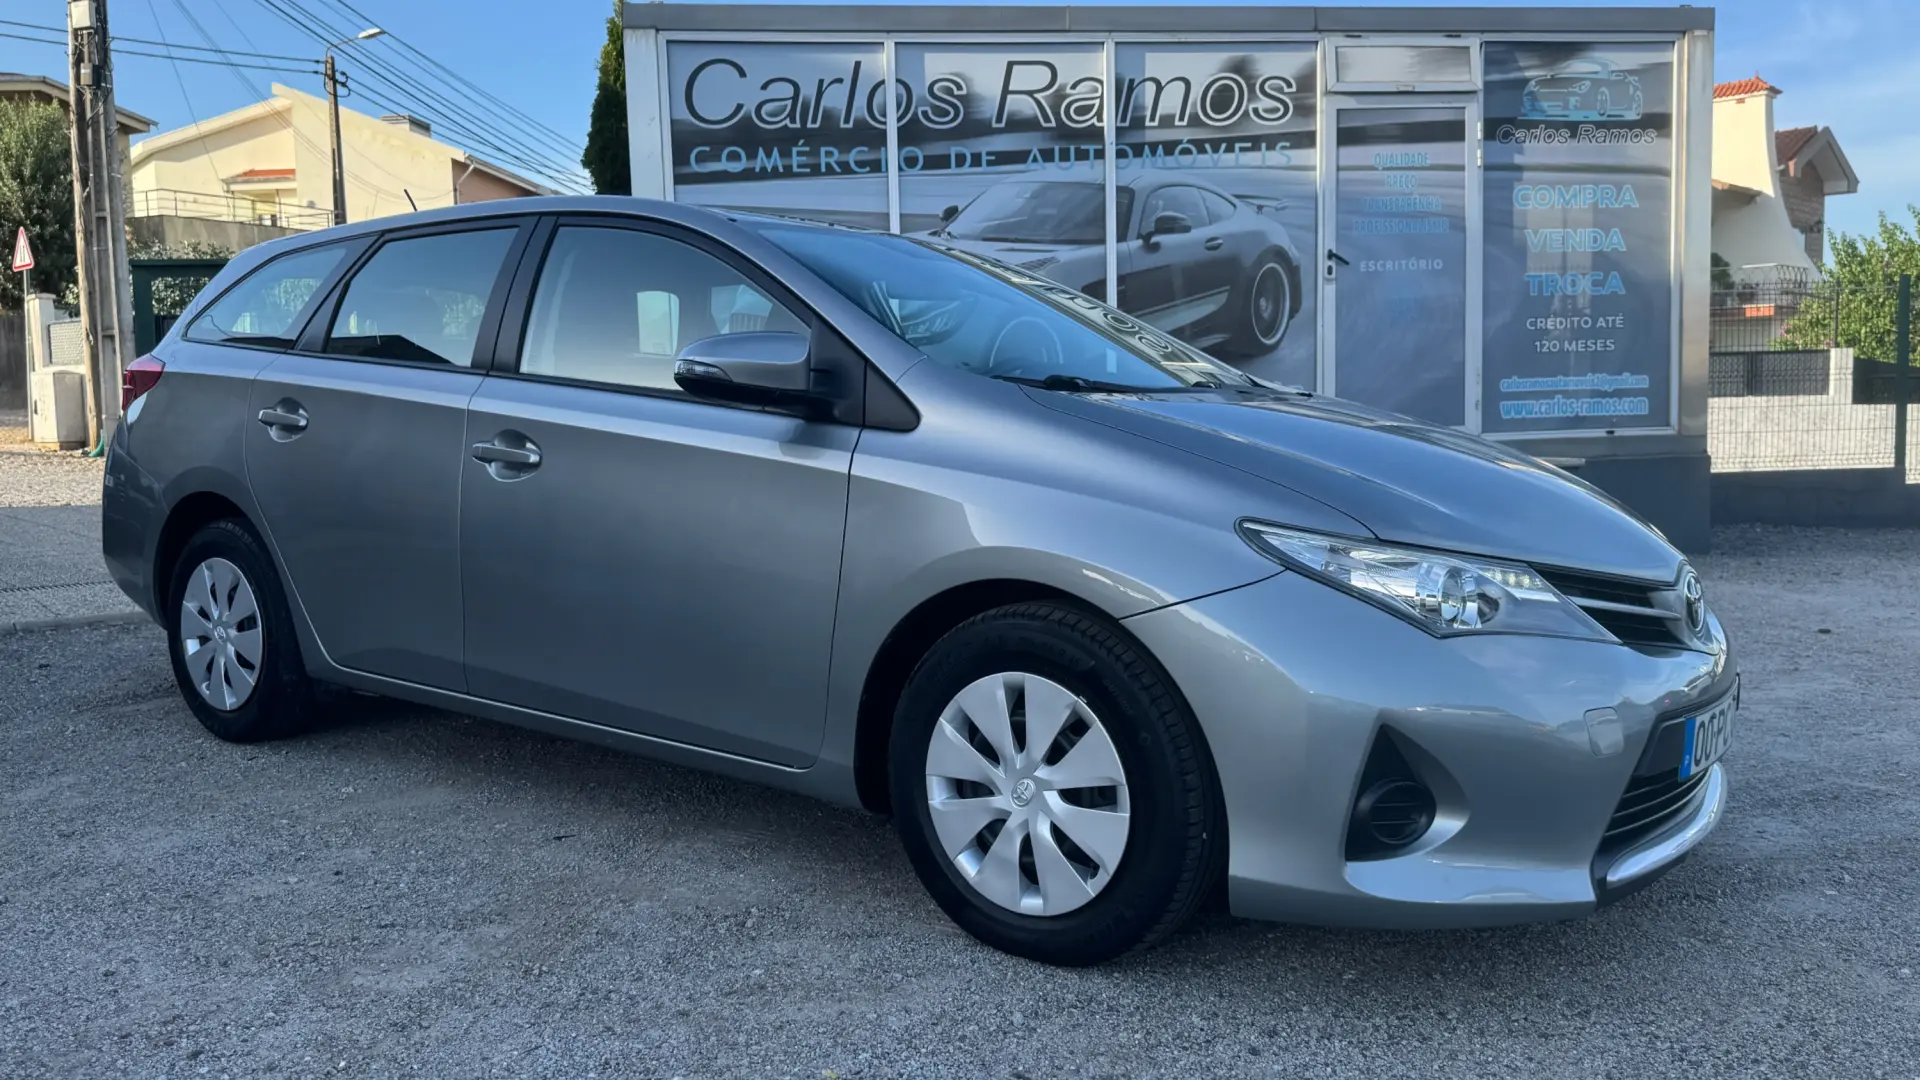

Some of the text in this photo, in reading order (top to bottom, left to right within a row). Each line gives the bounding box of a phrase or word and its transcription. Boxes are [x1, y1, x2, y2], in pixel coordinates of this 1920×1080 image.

[684, 57, 1297, 130] Carlos Ramos
[1496, 124, 1658, 145] Carlos Ramos
[689, 137, 1293, 173] COMÉRCIO DE AUTOMÓVEIS
[1374, 152, 1430, 170] QUALIDADE
[1386, 172, 1418, 193] PREÇO
[1513, 184, 1639, 209] COMPRA
[1523, 228, 1627, 253] VENDA
[1360, 257, 1443, 272] ESCRITÓRIO
[1523, 271, 1627, 296] TROCA
[1526, 313, 1624, 330] CRÉDITO ATÉ
[1534, 339, 1615, 353] 120 MESES
[1500, 395, 1649, 419] www.carlos-ramos.com
